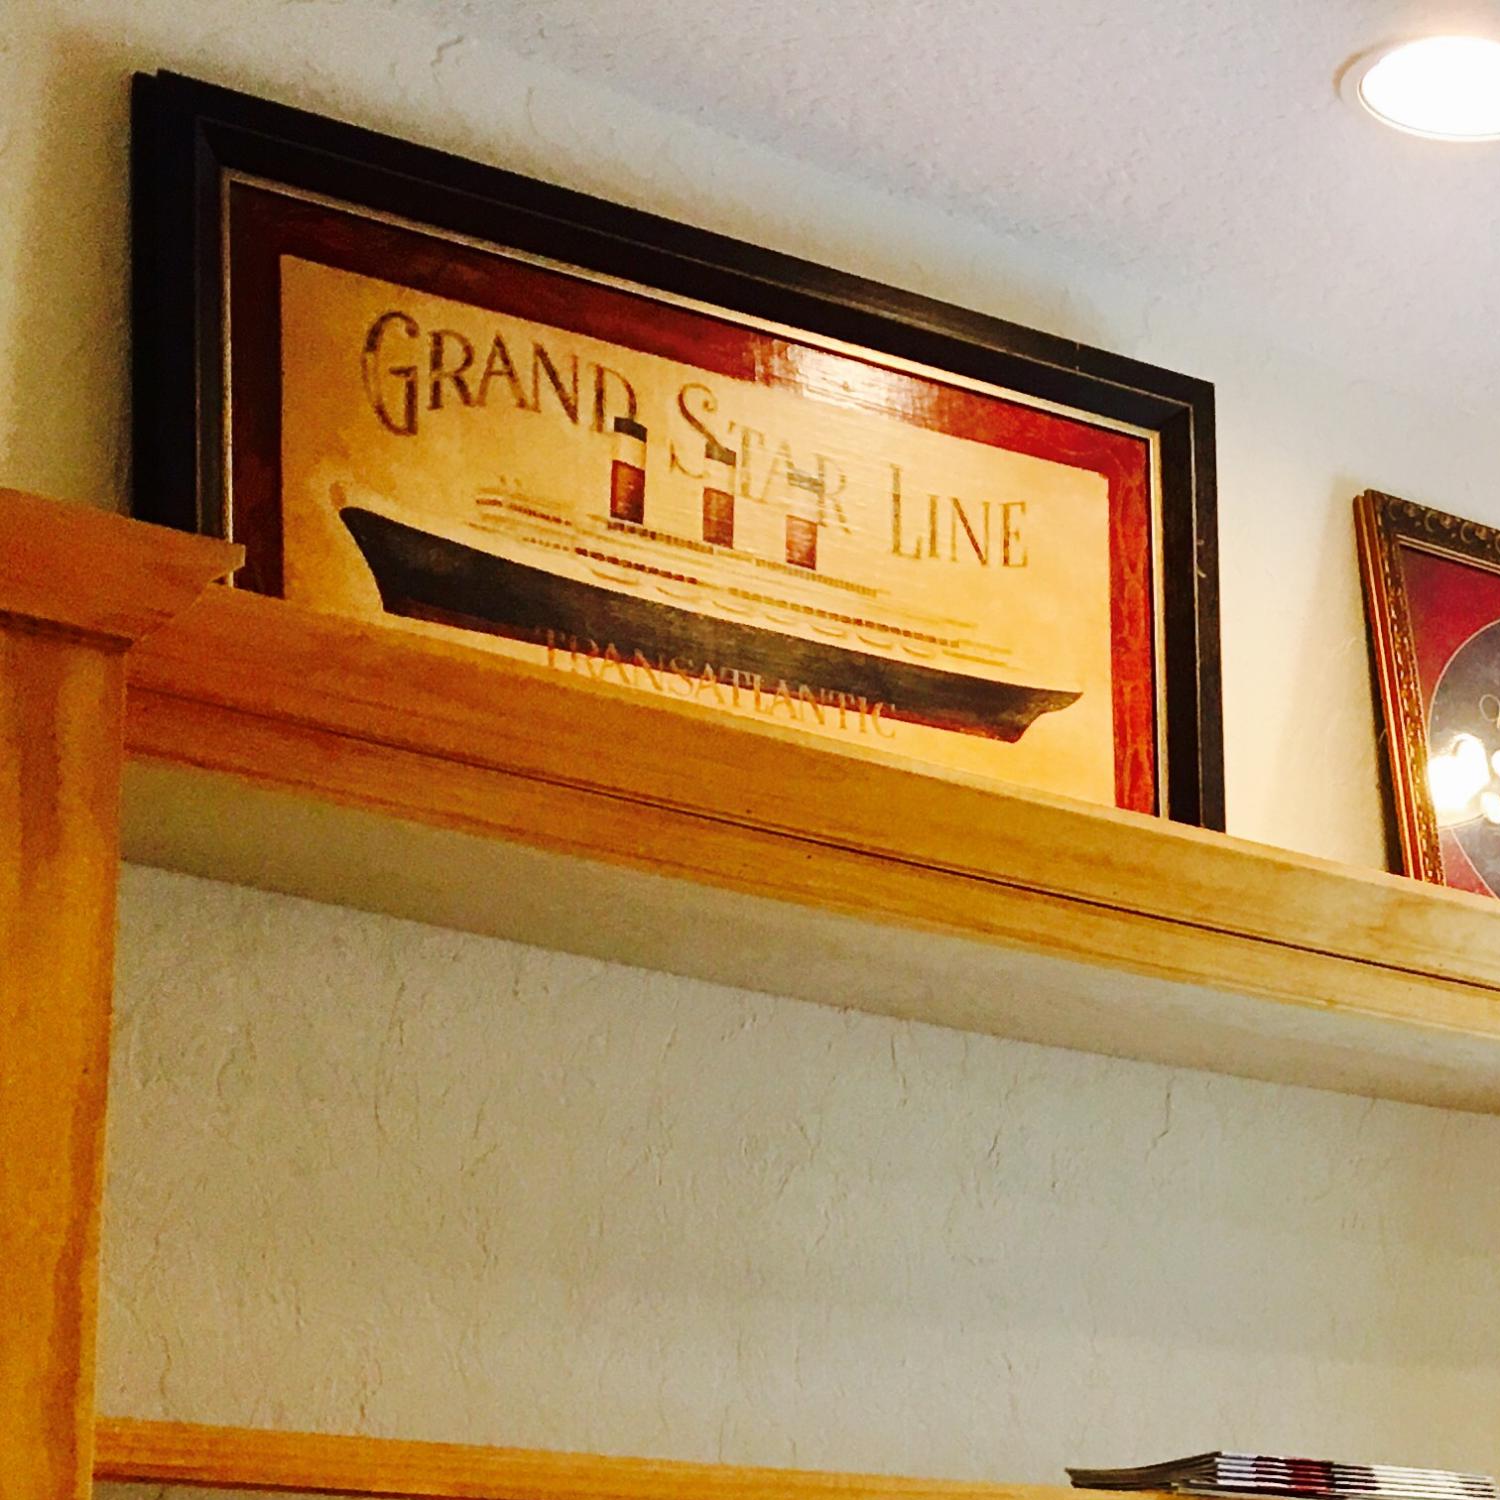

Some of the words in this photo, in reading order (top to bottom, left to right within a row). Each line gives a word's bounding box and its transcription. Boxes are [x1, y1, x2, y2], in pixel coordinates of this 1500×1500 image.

[360, 310, 638, 436] GRAND
[668, 382, 852, 534] STAR
[888, 462, 1029, 569] LINE
[538, 628, 897, 739] TRANSATLANTIC
